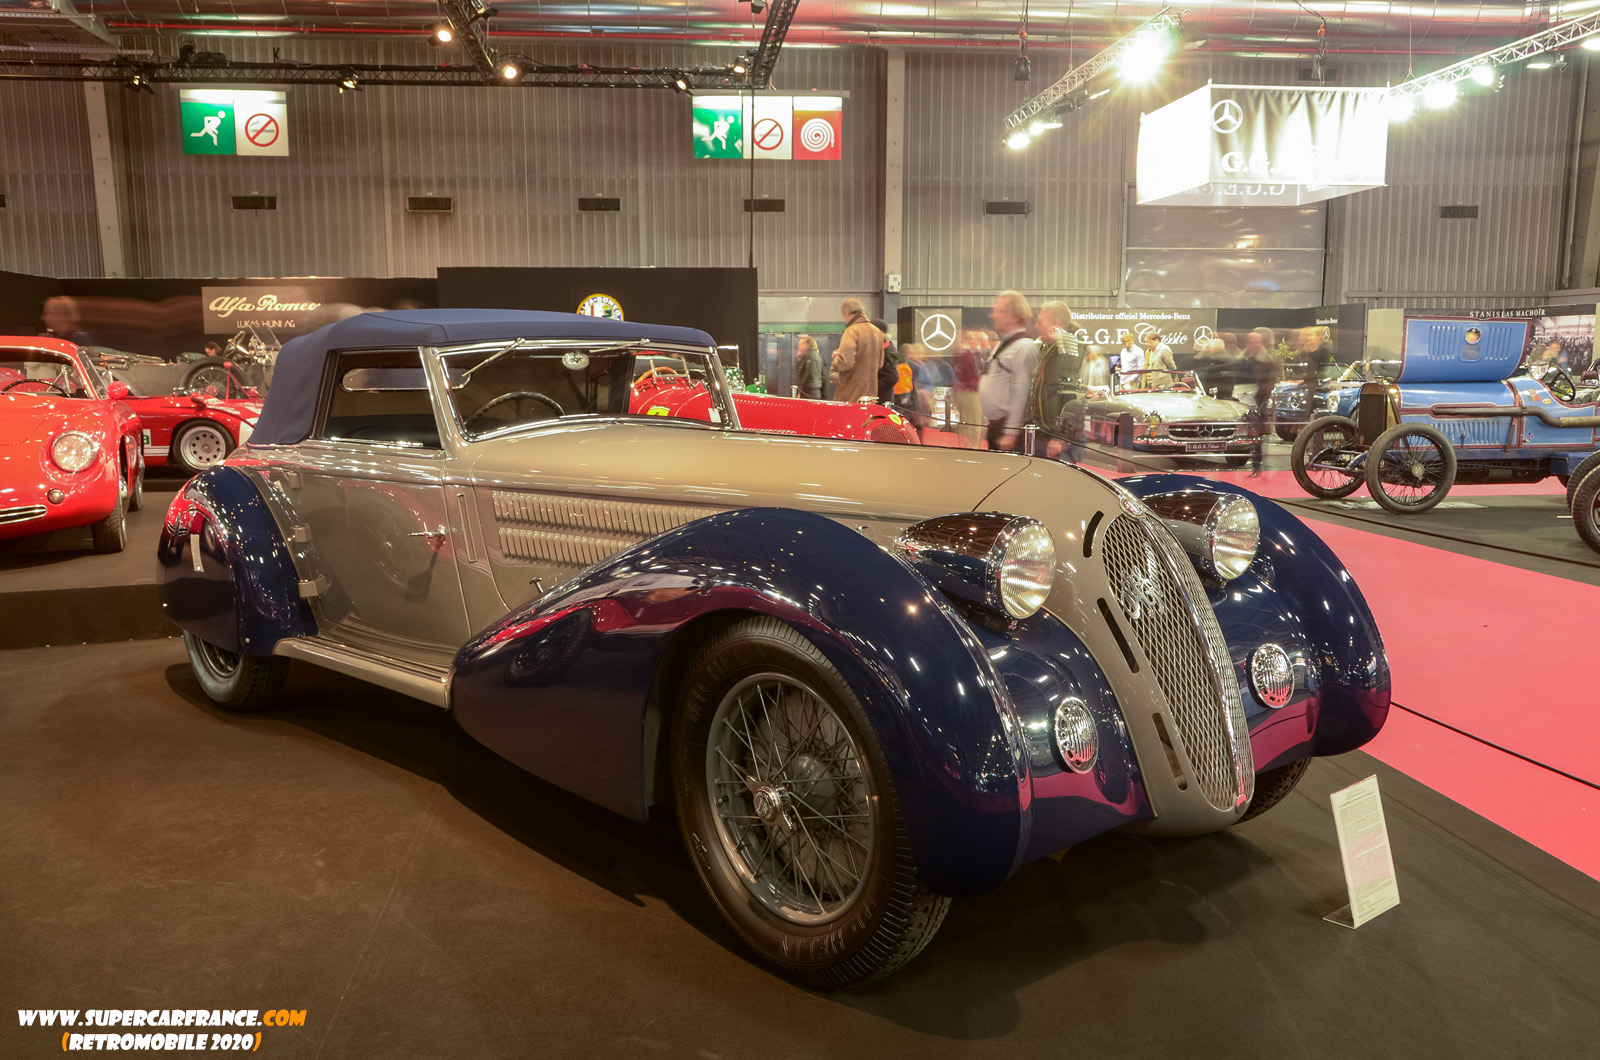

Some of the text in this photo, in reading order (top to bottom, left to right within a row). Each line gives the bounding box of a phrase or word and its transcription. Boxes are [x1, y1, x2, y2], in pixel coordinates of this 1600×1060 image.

[208, 294, 321, 318] Alfa Romeo
[1071, 312, 1191, 320] Distributeur officiel Mercedes-Benz
[1469, 310, 1514, 318] STANISLAS
[236, 320, 260, 329] LUKAS
[284, 320, 295, 328] AG
